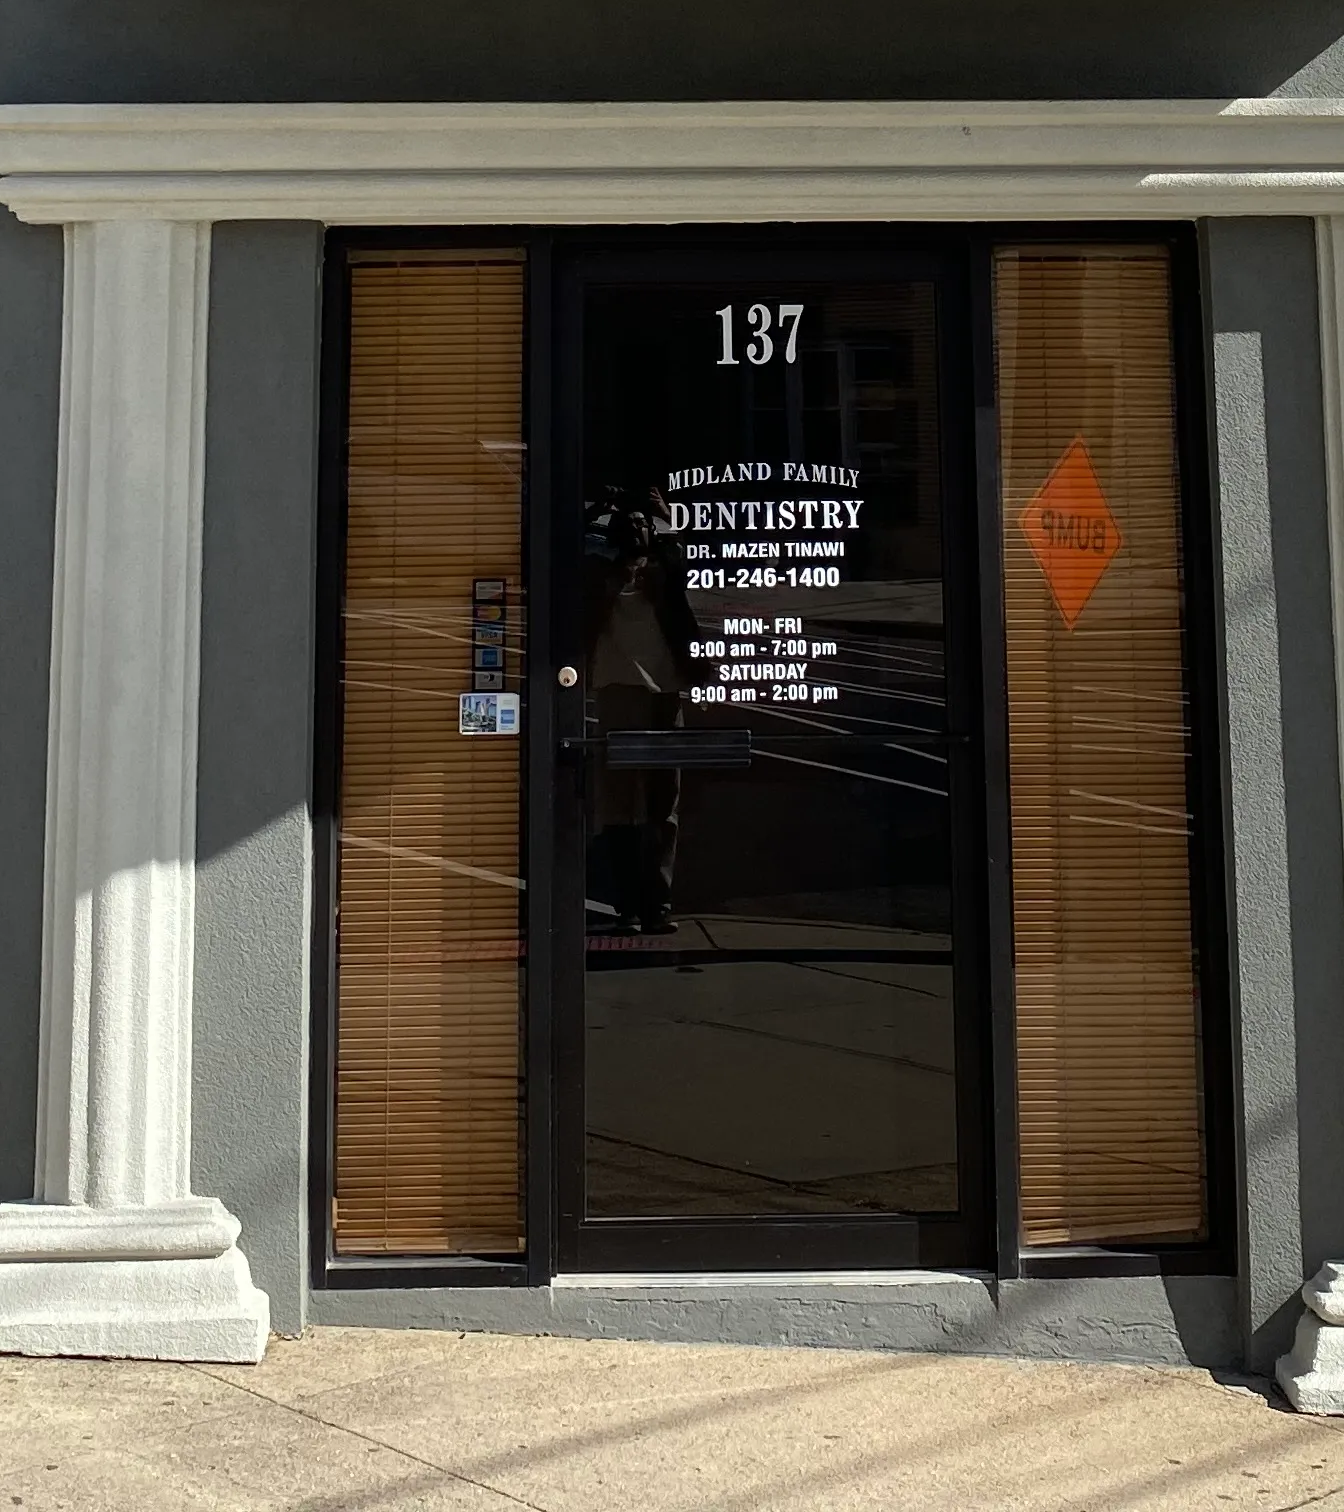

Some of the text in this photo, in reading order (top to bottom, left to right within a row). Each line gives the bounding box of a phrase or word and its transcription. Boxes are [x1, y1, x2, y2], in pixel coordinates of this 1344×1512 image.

[716, 304, 804, 365] 137
[668, 462, 860, 491] MIDLAND FAMILY
[669, 500, 864, 531] DENTISTRY
[687, 541, 845, 559] DR. MAZEN TINAWI
[686, 567, 840, 589] 201-246-1400
[724, 618, 802, 635] MON- FRI
[690, 641, 725, 658] 9:00
[731, 645, 754, 657] am
[772, 640, 807, 657] 7:00
[812, 643, 837, 660] pm
[719, 663, 807, 681] SATURDAY
[691, 687, 726, 704] 9:00
[732, 691, 755, 703] am
[772, 686, 808, 702] 2:00
[813, 688, 838, 705] pm
